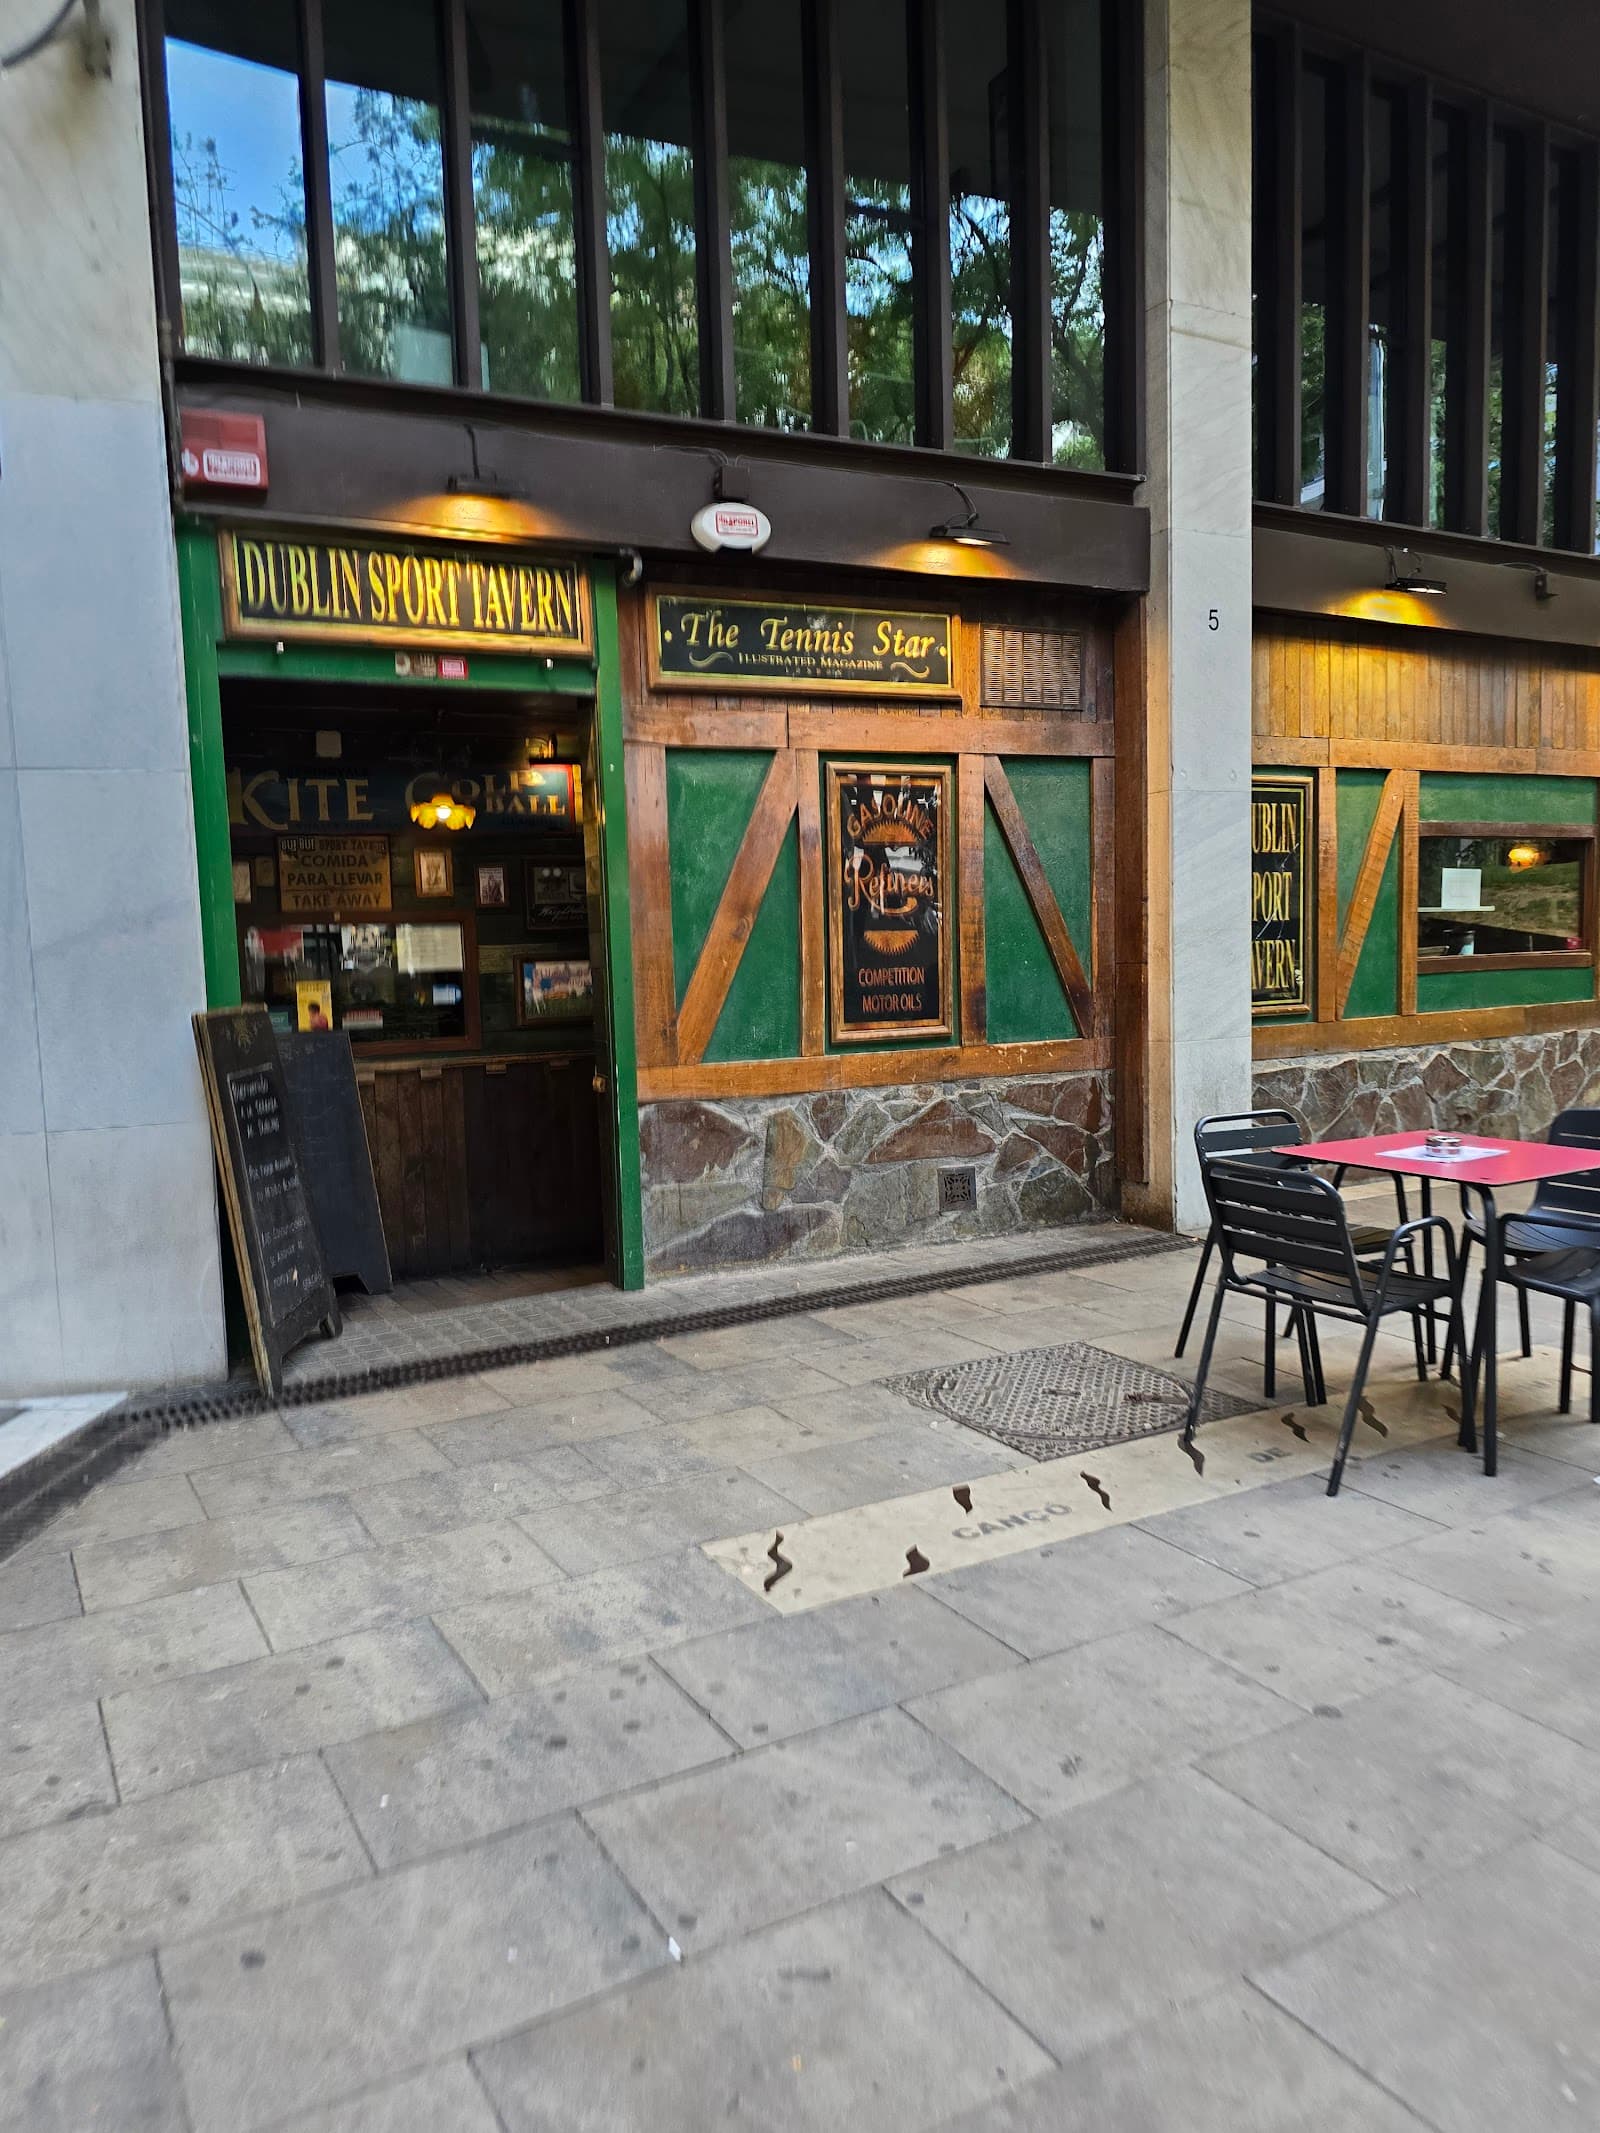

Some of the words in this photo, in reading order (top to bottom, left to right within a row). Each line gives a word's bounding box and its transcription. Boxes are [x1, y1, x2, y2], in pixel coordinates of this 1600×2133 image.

[242, 540, 363, 622] DUBLIN
[367, 551, 462, 627] SPORT
[464, 562, 575, 633] TAVERN
[1208, 609, 1220, 632] 5
[681, 610, 739, 649] The
[761, 616, 855, 654] Tennis
[873, 620, 935, 658] Star
[739, 652, 816, 667] ILLUSTRATED
[820, 656, 883, 672] MAGAZINE
[228, 765, 375, 832] KITE
[485, 794, 567, 816] BALL
[847, 793, 935, 841] GASOLINE
[1251, 803, 1296, 853] UBLIN
[301, 854, 369, 868] COMIDA
[287, 872, 328, 886] PARA
[333, 871, 383, 886] LLEVAR
[844, 854, 935, 914] Refiners
[292, 894, 328, 908] TAKE
[337, 892, 382, 907] AWAY
[1251, 871, 1293, 922] PORT
[1251, 938, 1296, 990] AVERN
[858, 965, 925, 987] COMPETITION
[862, 993, 899, 1013] MOTOR
[900, 992, 922, 1012] OILS
[1248, 1446, 1292, 1463] DE
